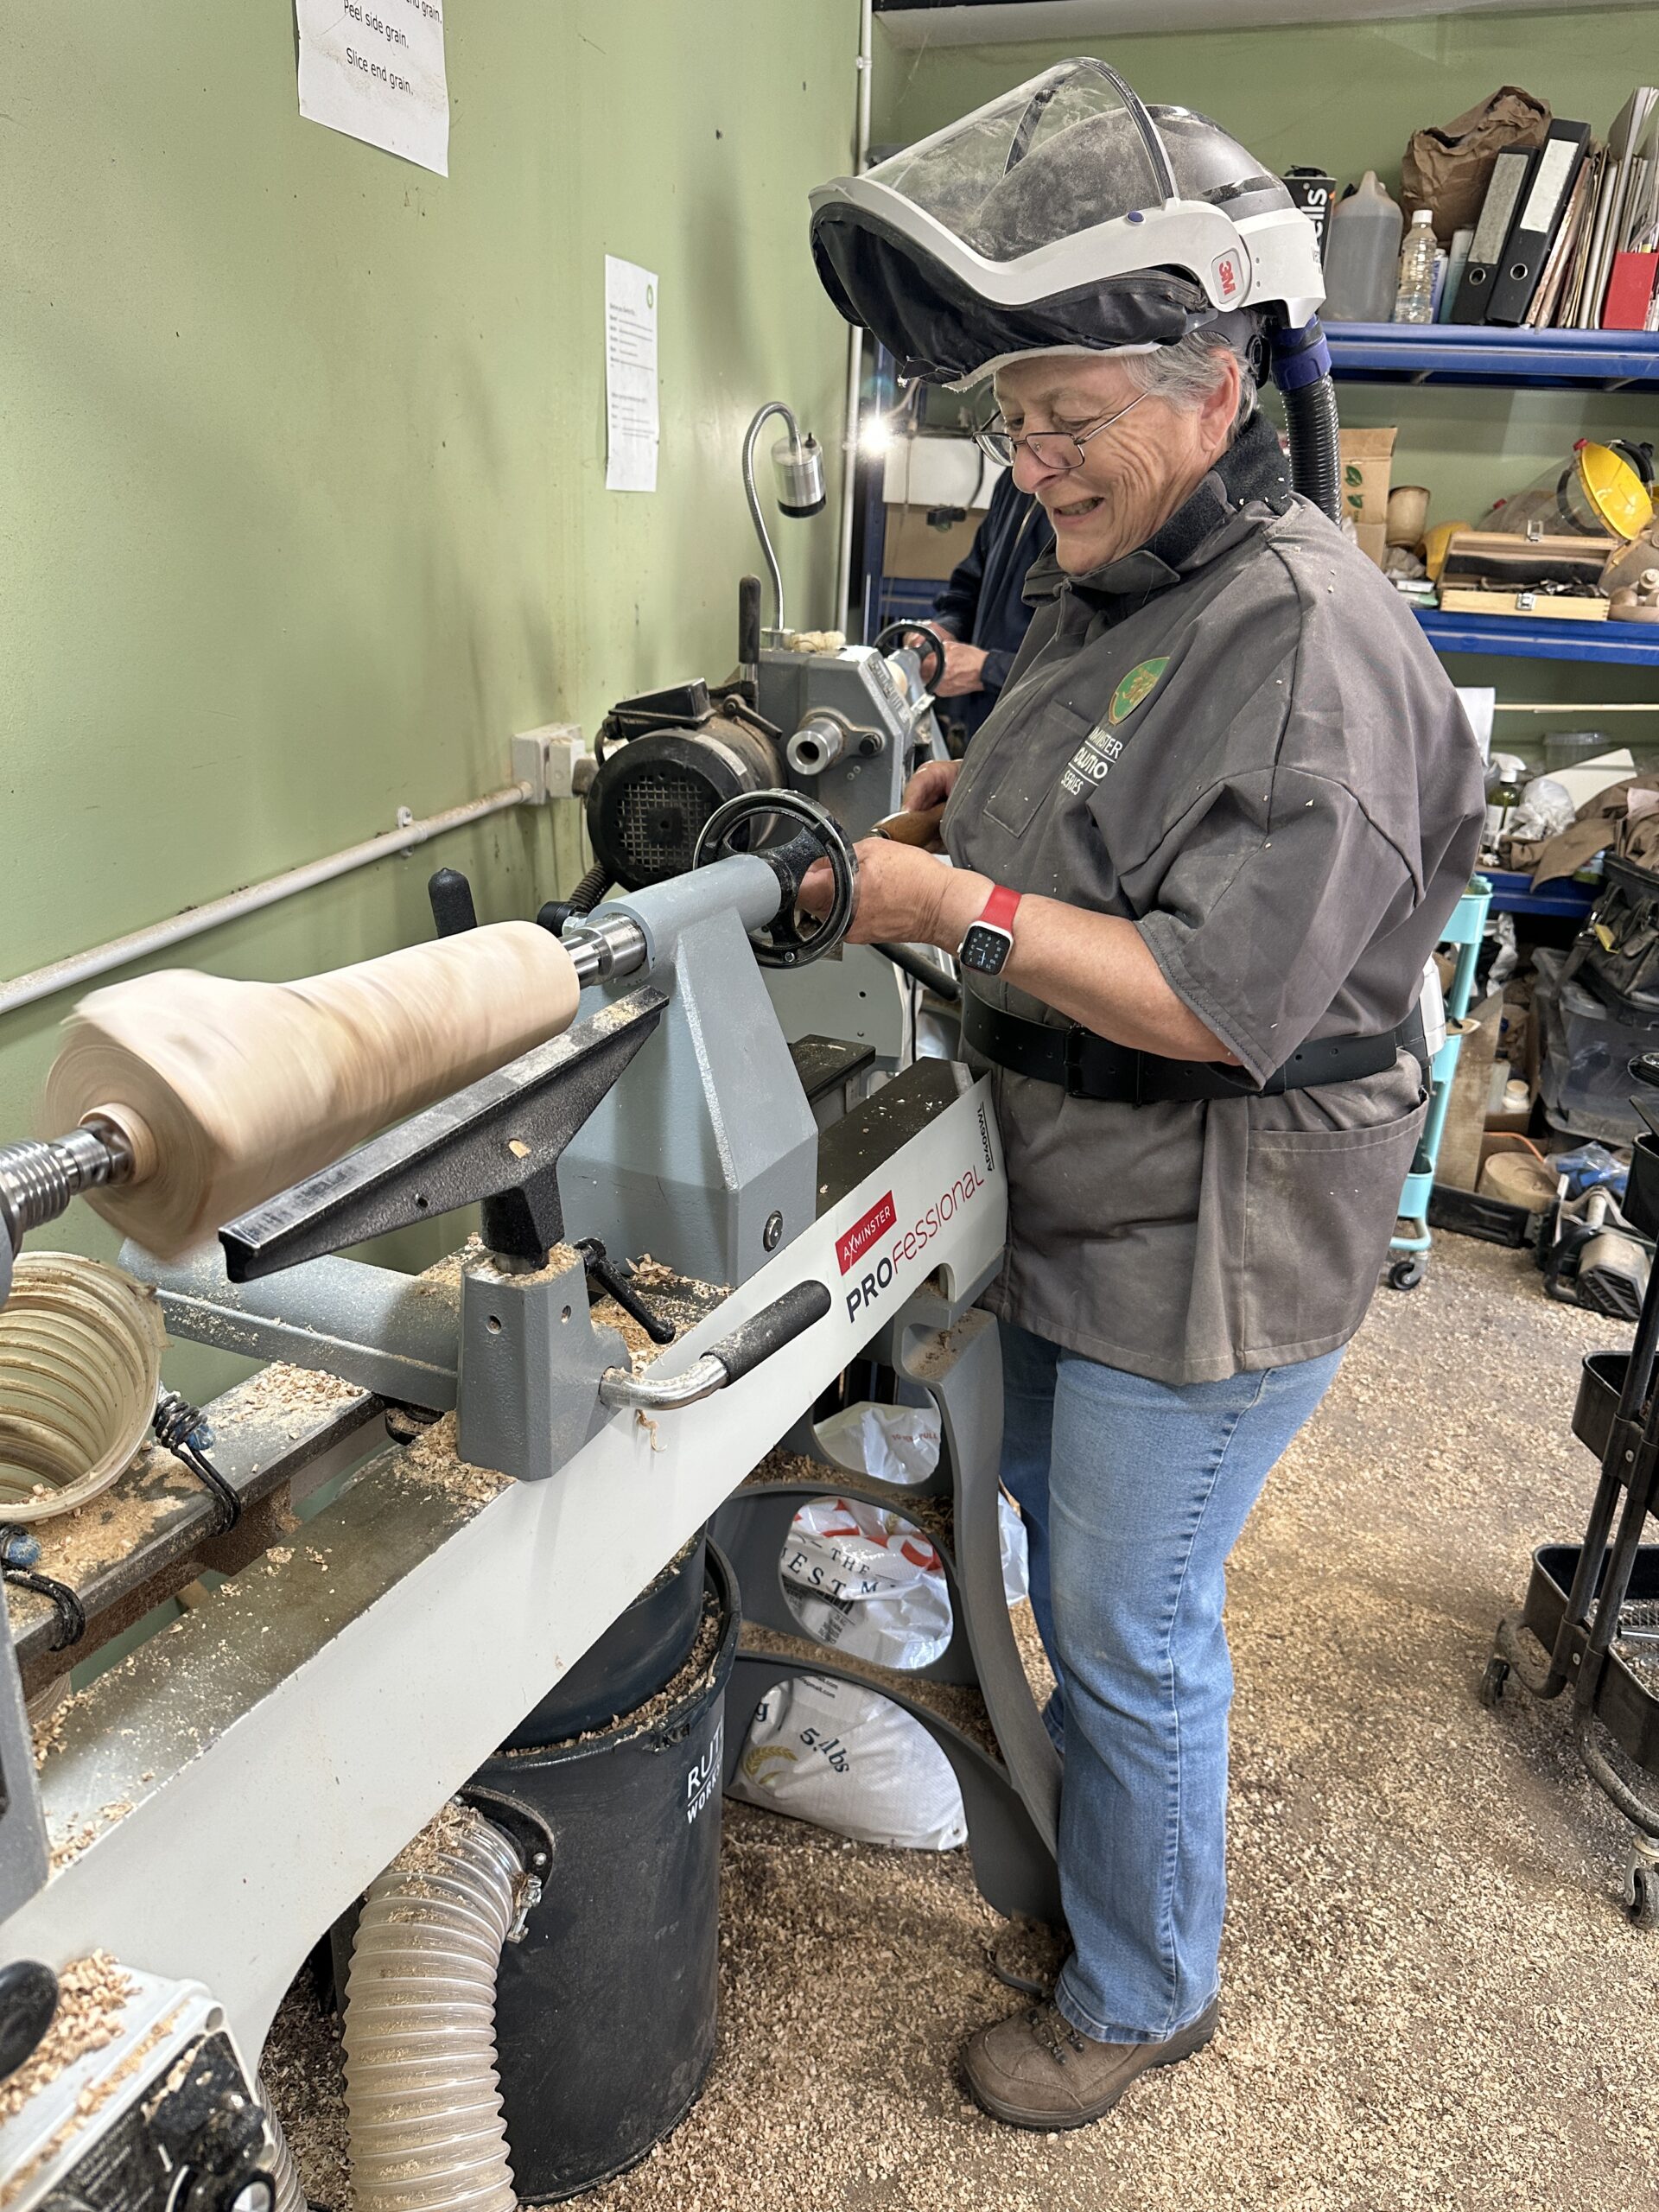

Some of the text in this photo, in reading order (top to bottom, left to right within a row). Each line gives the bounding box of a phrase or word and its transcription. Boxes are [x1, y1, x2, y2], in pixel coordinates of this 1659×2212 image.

[344, 1, 409, 48] Peel side grain.
[422, 1, 442, 24] grain.
[346, 48, 414, 95] Slice end grain.
[1218, 260, 1236, 296] 3M
[1060, 769, 1084, 796] SERIES
[977, 1103, 993, 1172] AP406WL
[842, 1205, 891, 1265] AXMINSTER
[830, 1548, 870, 1574] THE
